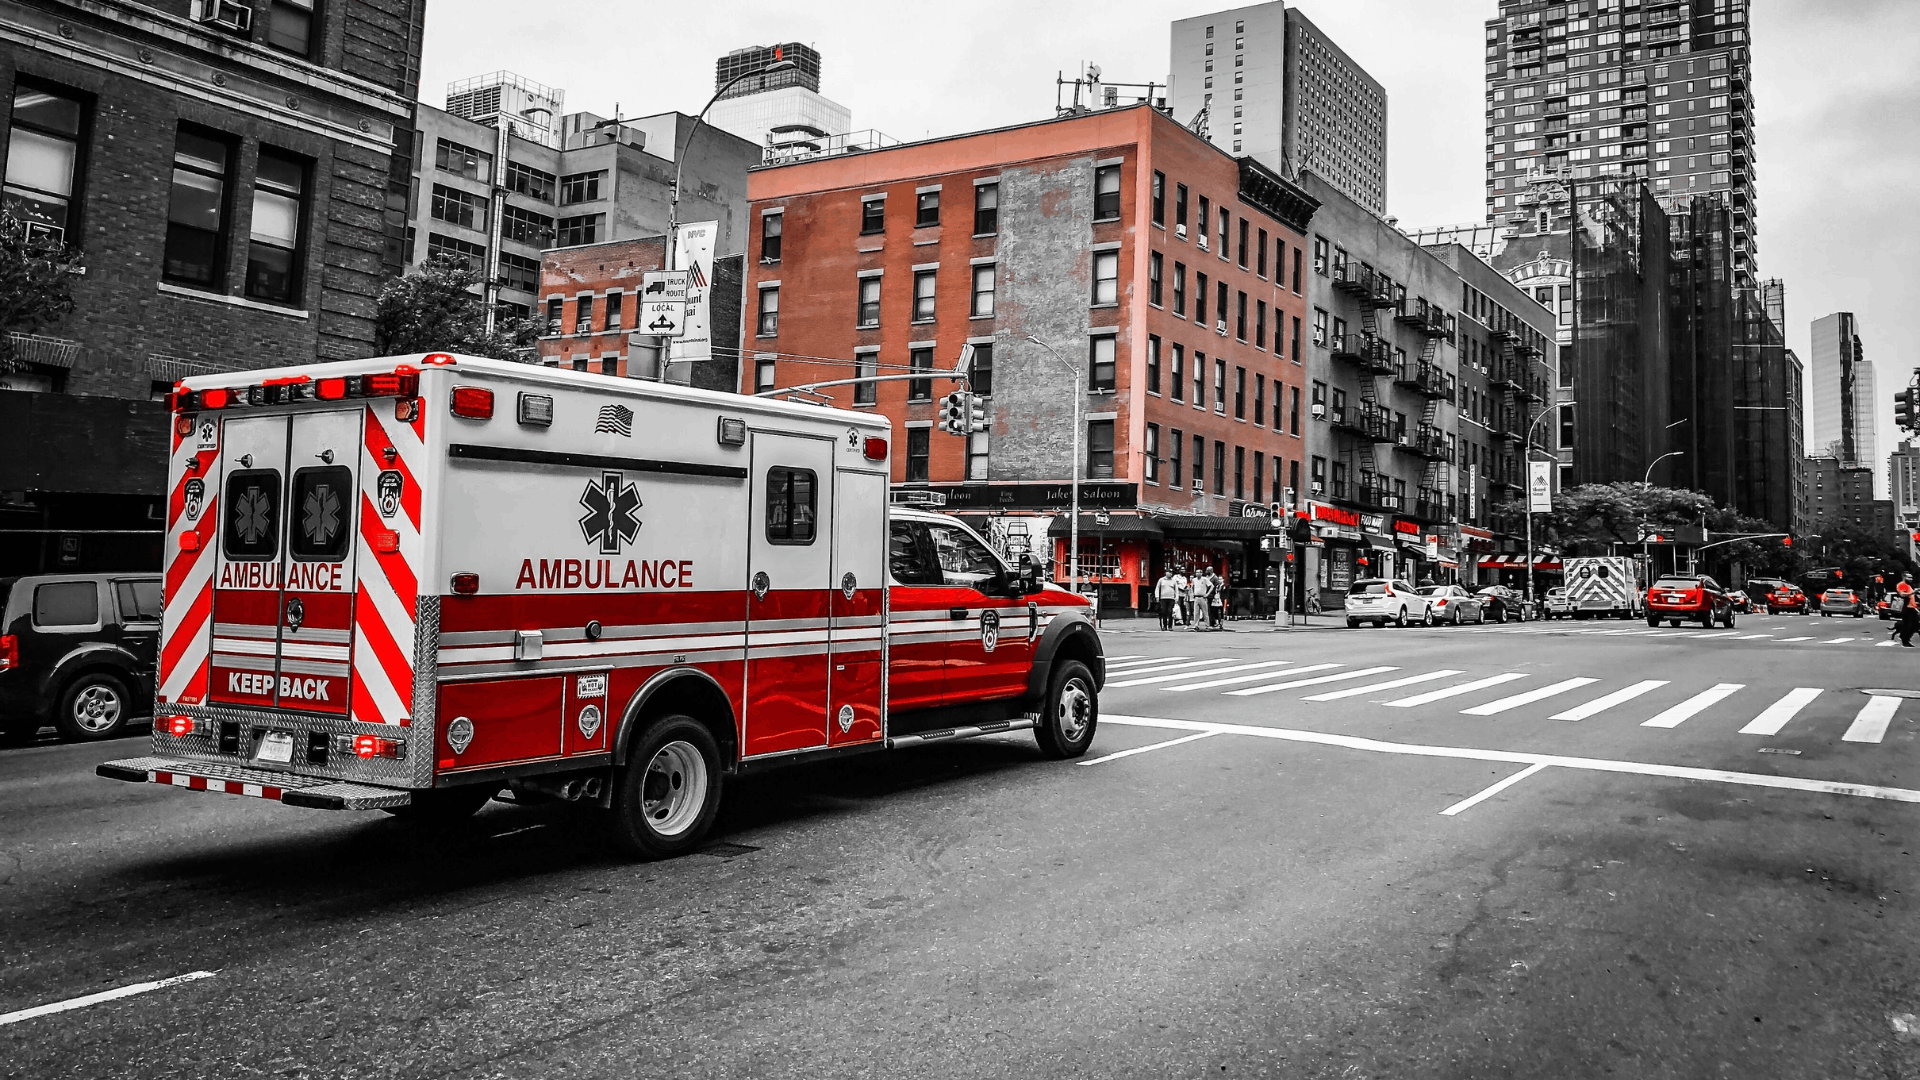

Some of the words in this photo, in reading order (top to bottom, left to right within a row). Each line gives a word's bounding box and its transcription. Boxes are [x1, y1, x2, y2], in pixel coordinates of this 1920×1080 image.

[687, 230, 706, 239] NYC
[666, 290, 685, 298] ROUTE
[652, 304, 675, 312] LOCAL
[1046, 487, 1072, 500] Jake'
[1083, 487, 1120, 499] Saloon
[220, 562, 343, 590] AMBULANCE
[515, 558, 693, 589] AMBULANCE
[228, 672, 275, 695] KEEP
[278, 676, 330, 701] BACK
